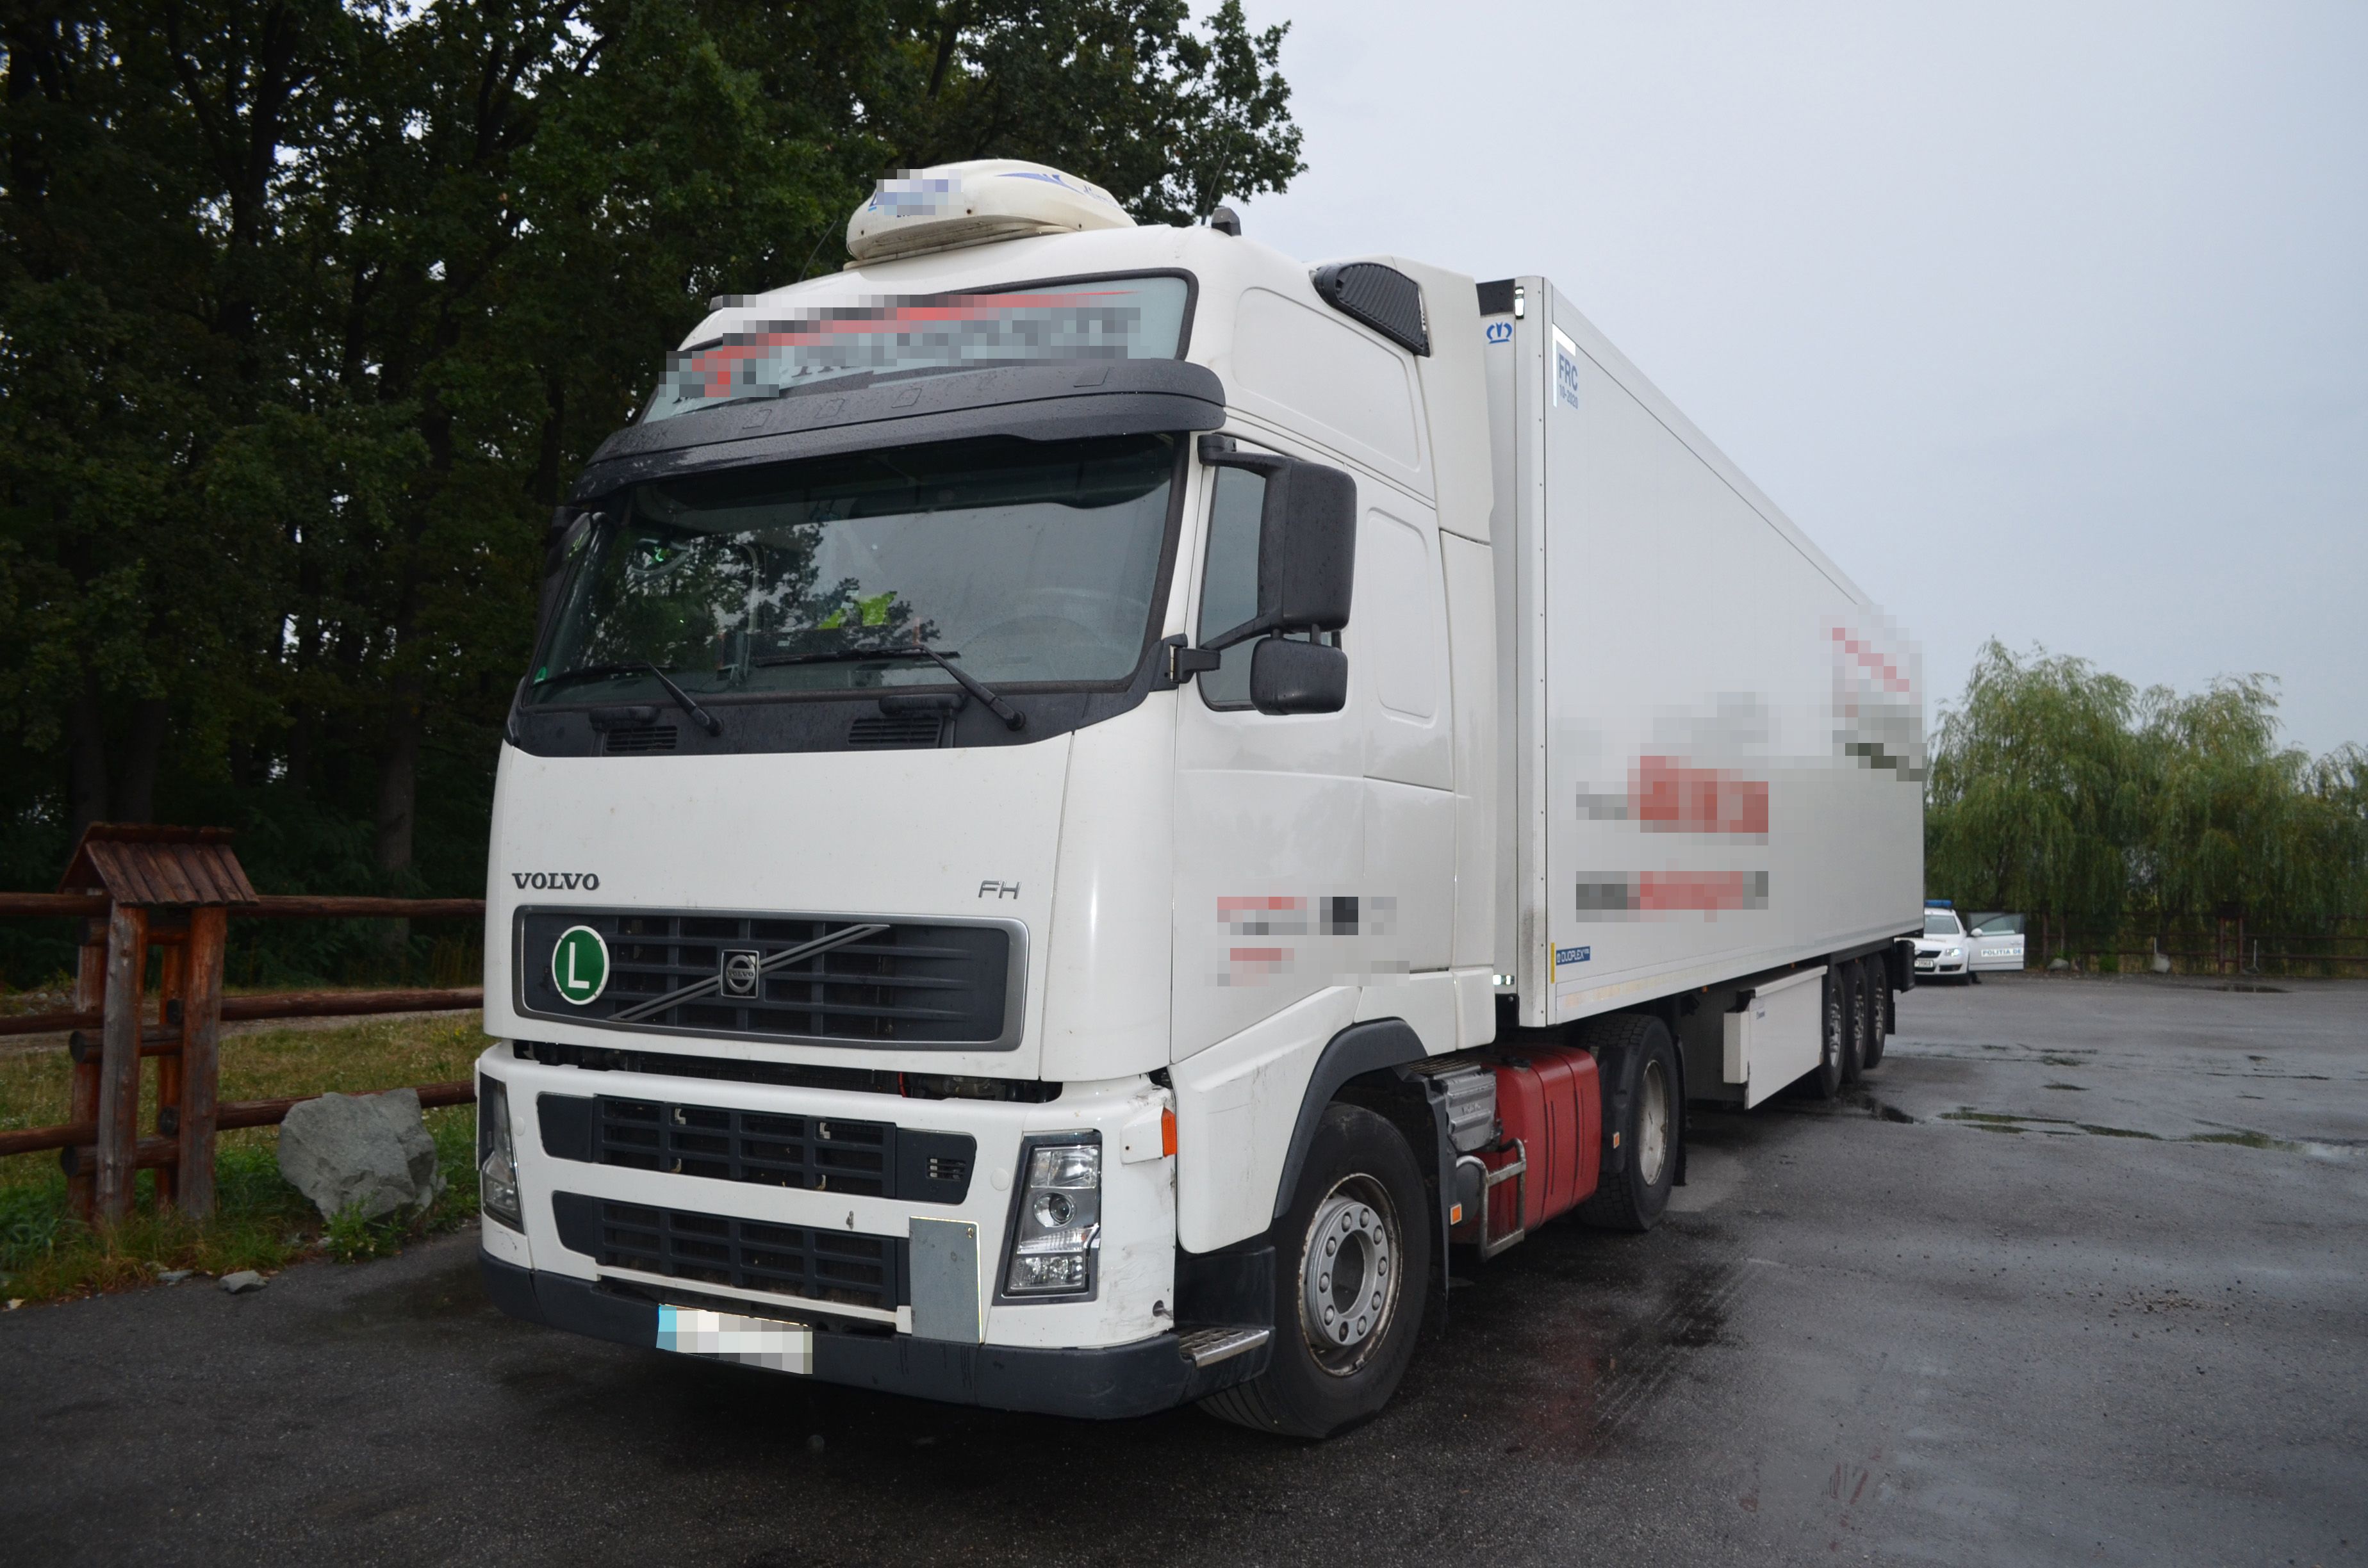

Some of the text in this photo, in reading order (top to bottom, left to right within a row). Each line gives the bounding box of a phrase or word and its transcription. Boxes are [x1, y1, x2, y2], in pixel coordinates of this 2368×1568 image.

[1559, 353, 1577, 391] FRC
[512, 872, 600, 890] VOLVO
[978, 880, 1021, 899] FH
[568, 942, 589, 988] L
[1561, 949, 1584, 962] DUOPLEX
